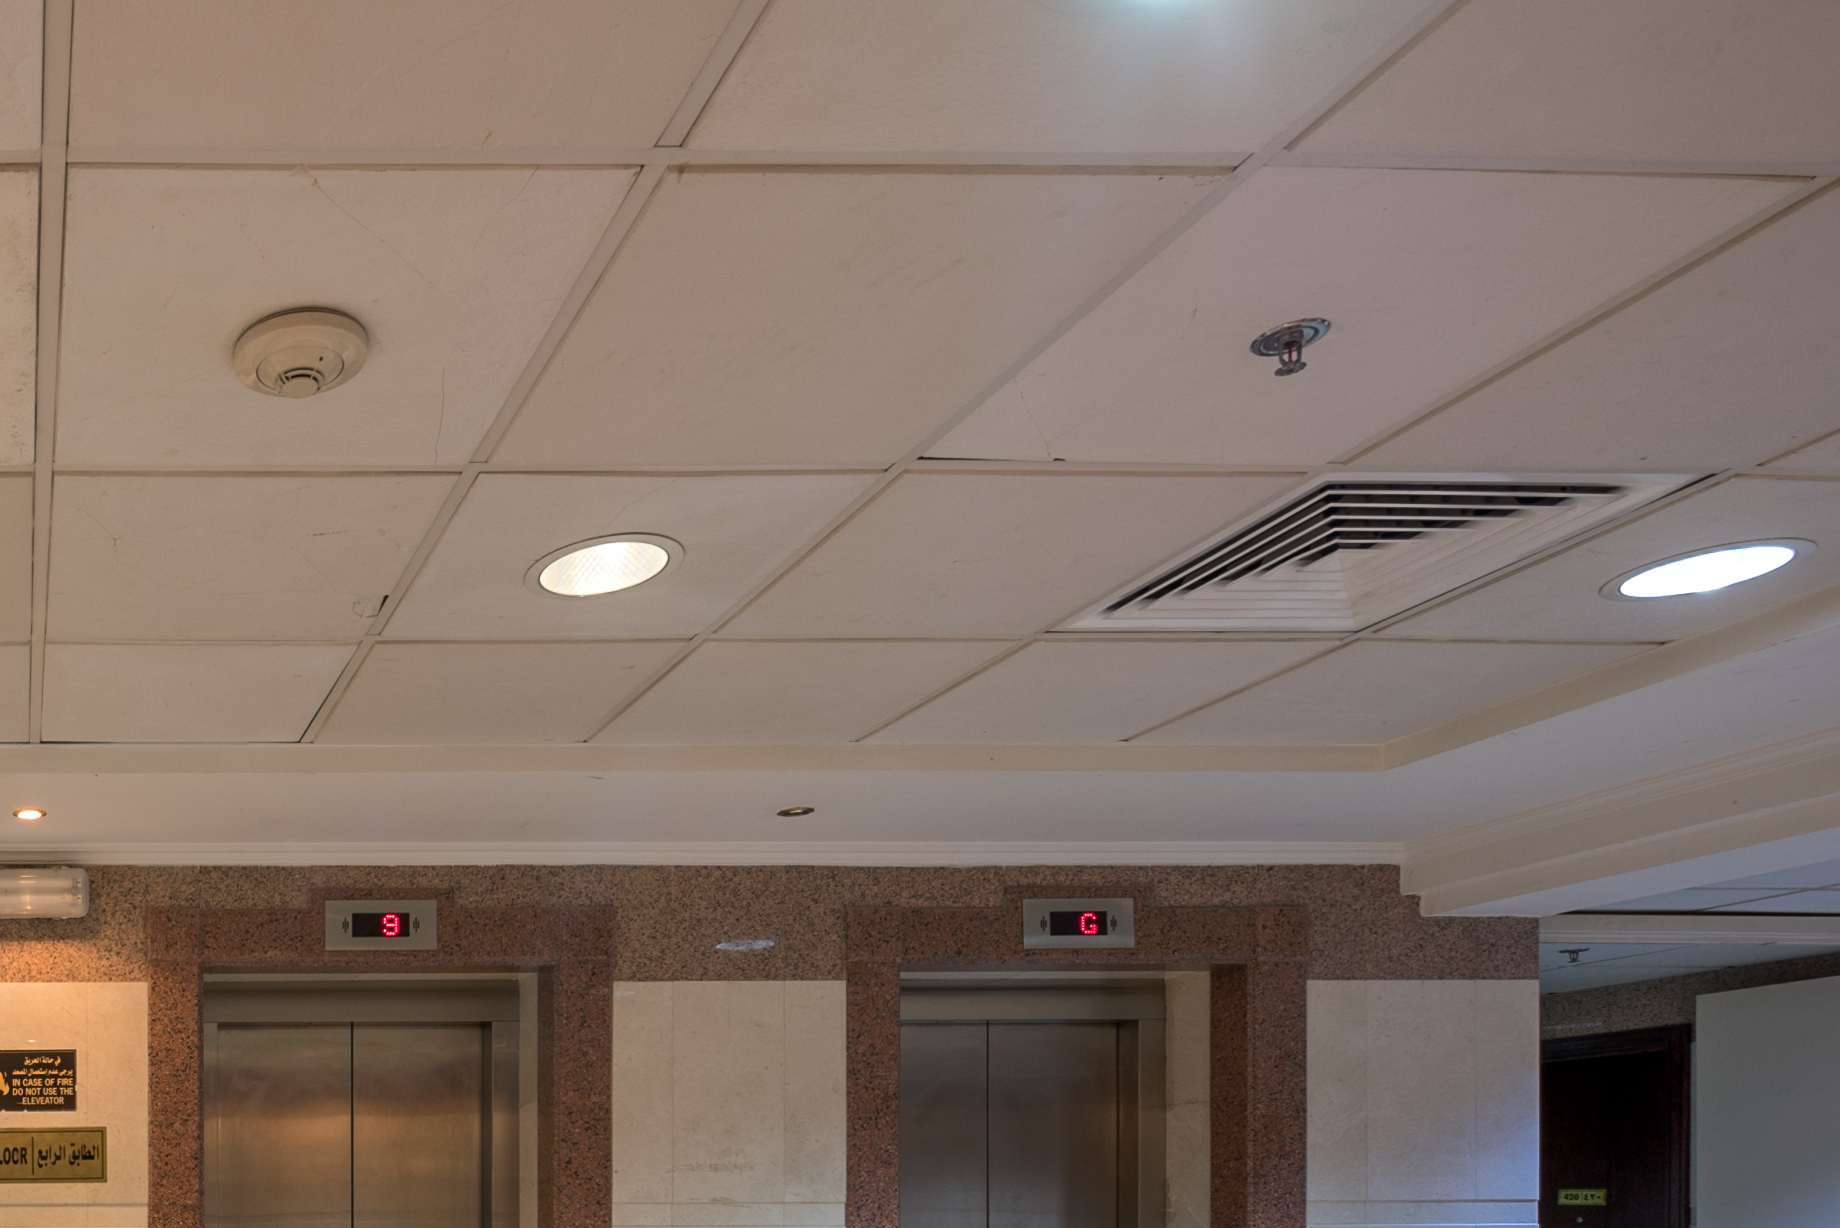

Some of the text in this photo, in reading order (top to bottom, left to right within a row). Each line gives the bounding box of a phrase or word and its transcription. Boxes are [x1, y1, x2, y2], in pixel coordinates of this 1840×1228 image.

[382, 913, 400, 937] 9
[1080, 912, 1098, 935] G
[24, 1056, 41, 1066] الحريق
[12, 1077, 74, 1087] IN CASE OF FIRE
[12, 1087, 74, 1096] DO NOT USE THE
[22, 1096, 65, 1105] ELEVEATOR
[37, 1142, 100, 1168] الطابق الرابع
[1563, 1193, 1580, 1201] 420
